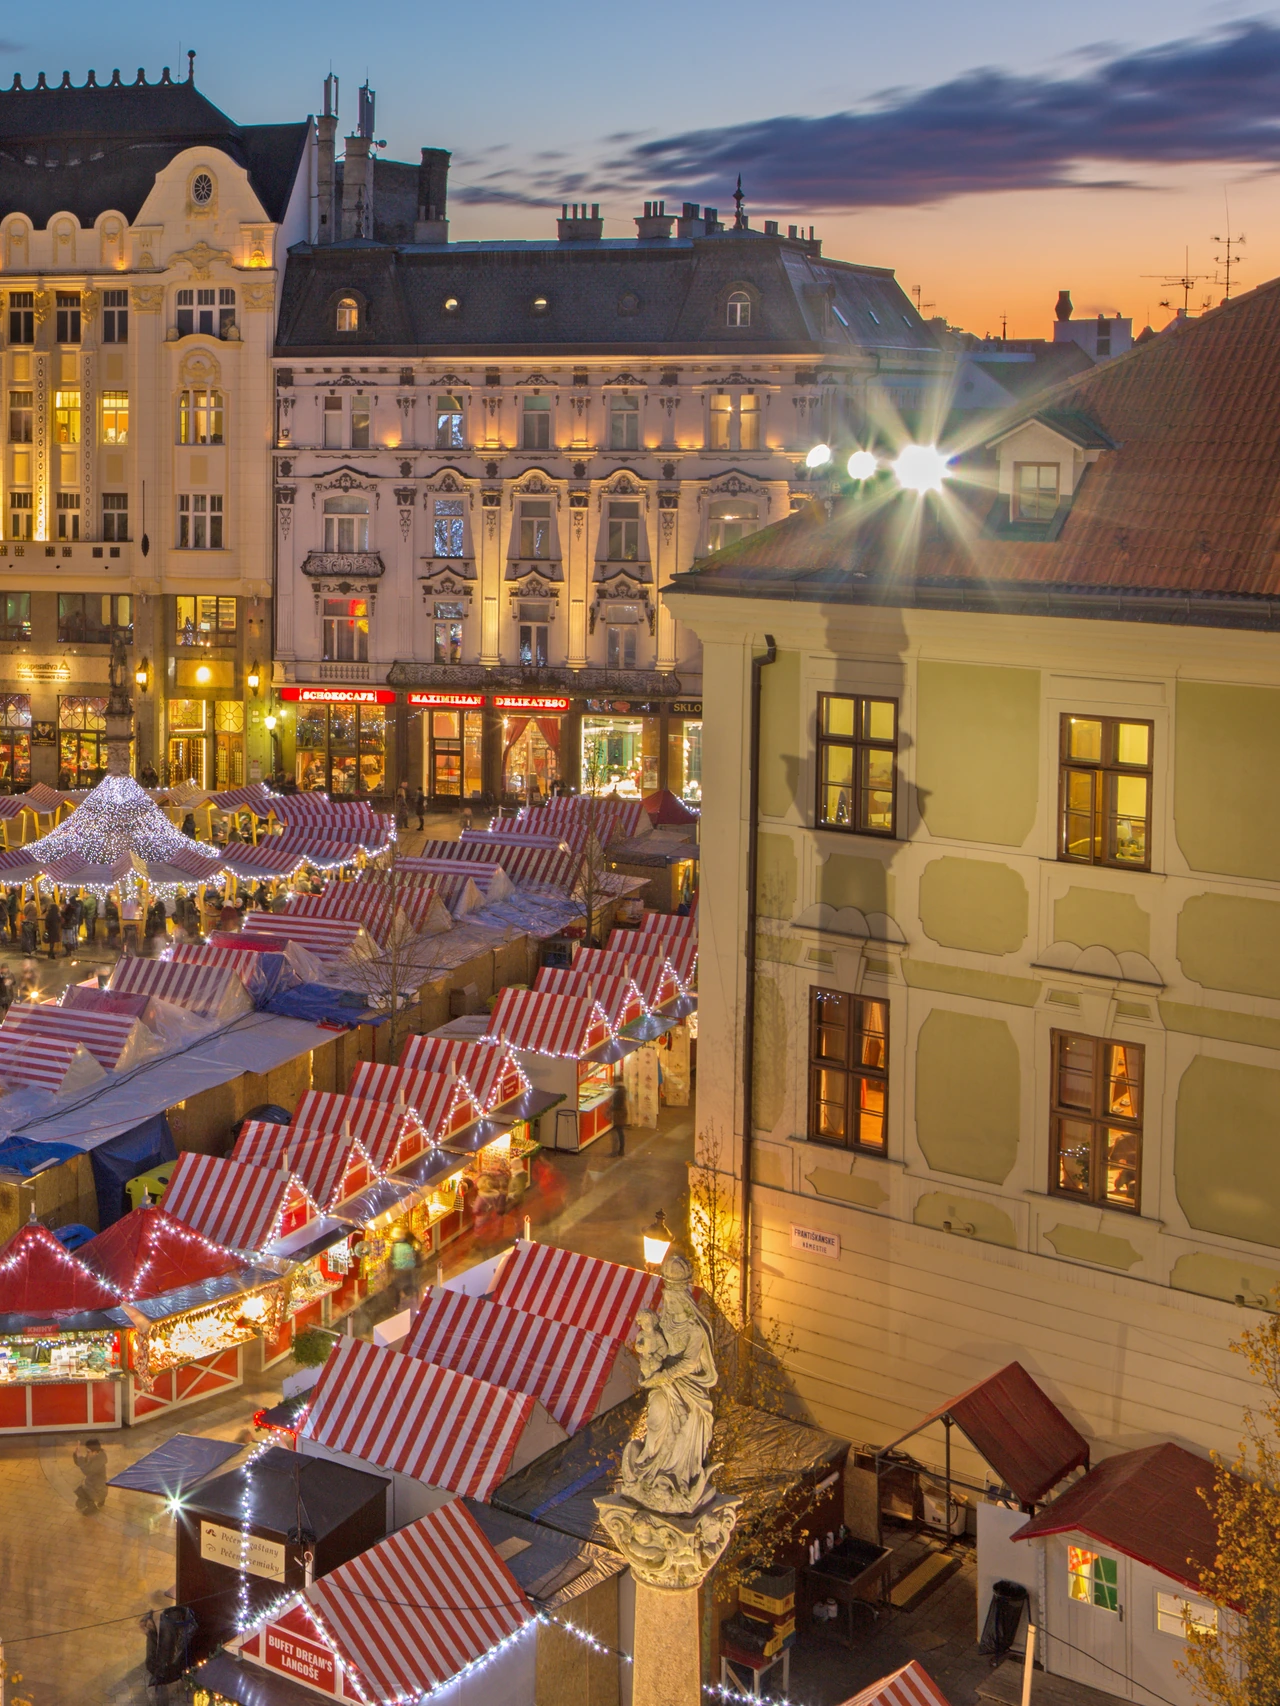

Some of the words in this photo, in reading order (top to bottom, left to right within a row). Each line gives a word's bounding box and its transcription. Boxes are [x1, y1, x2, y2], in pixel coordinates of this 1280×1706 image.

[411, 694, 482, 704] MAXIMILIAN
[495, 697, 567, 708] DELIKATESO
[673, 703, 702, 713] SKLO
[794, 1228, 835, 1246] FRANTIŠKÁNSKE
[27, 1325, 53, 1333] KNIHY
[249, 1541, 279, 1558] gaštany
[268, 1634, 294, 1655] BUFET
[296, 1646, 333, 1673] DREAM'S
[281, 1654, 319, 1681] LANGOŠE
